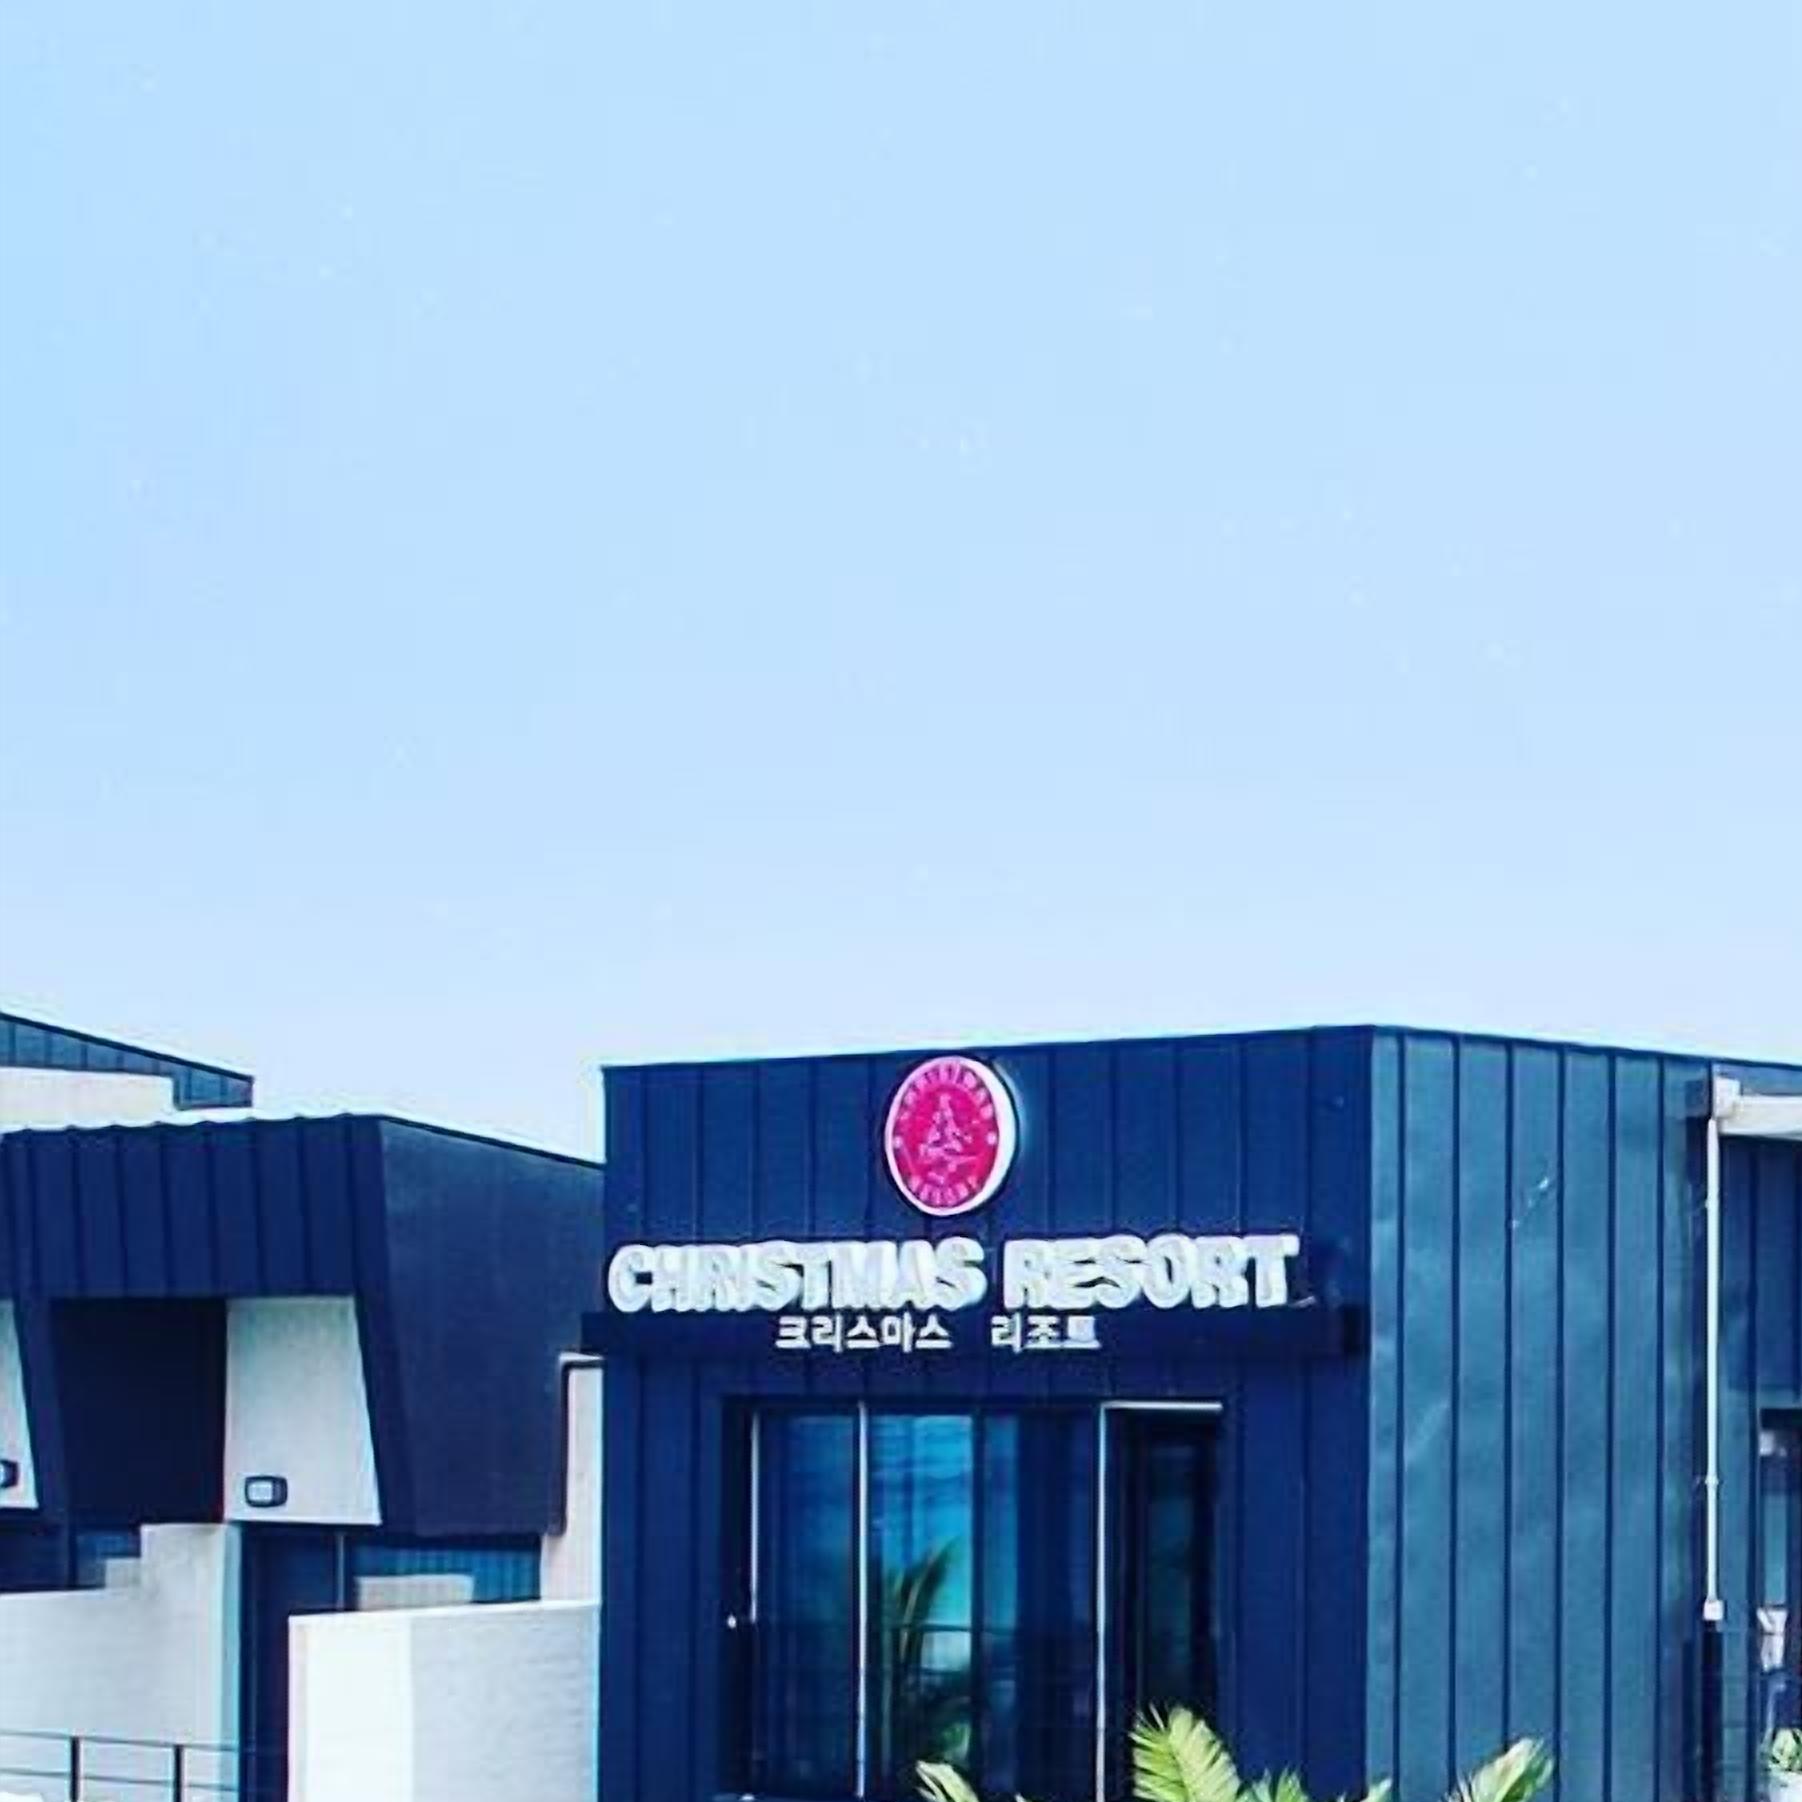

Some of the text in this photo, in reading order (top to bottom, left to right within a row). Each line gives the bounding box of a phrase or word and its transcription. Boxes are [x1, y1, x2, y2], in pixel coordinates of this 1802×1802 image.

[608, 1234, 1299, 1312] CHRISTMAS RESORT
[775, 1313, 1100, 1352] 크리스마스 리조트
